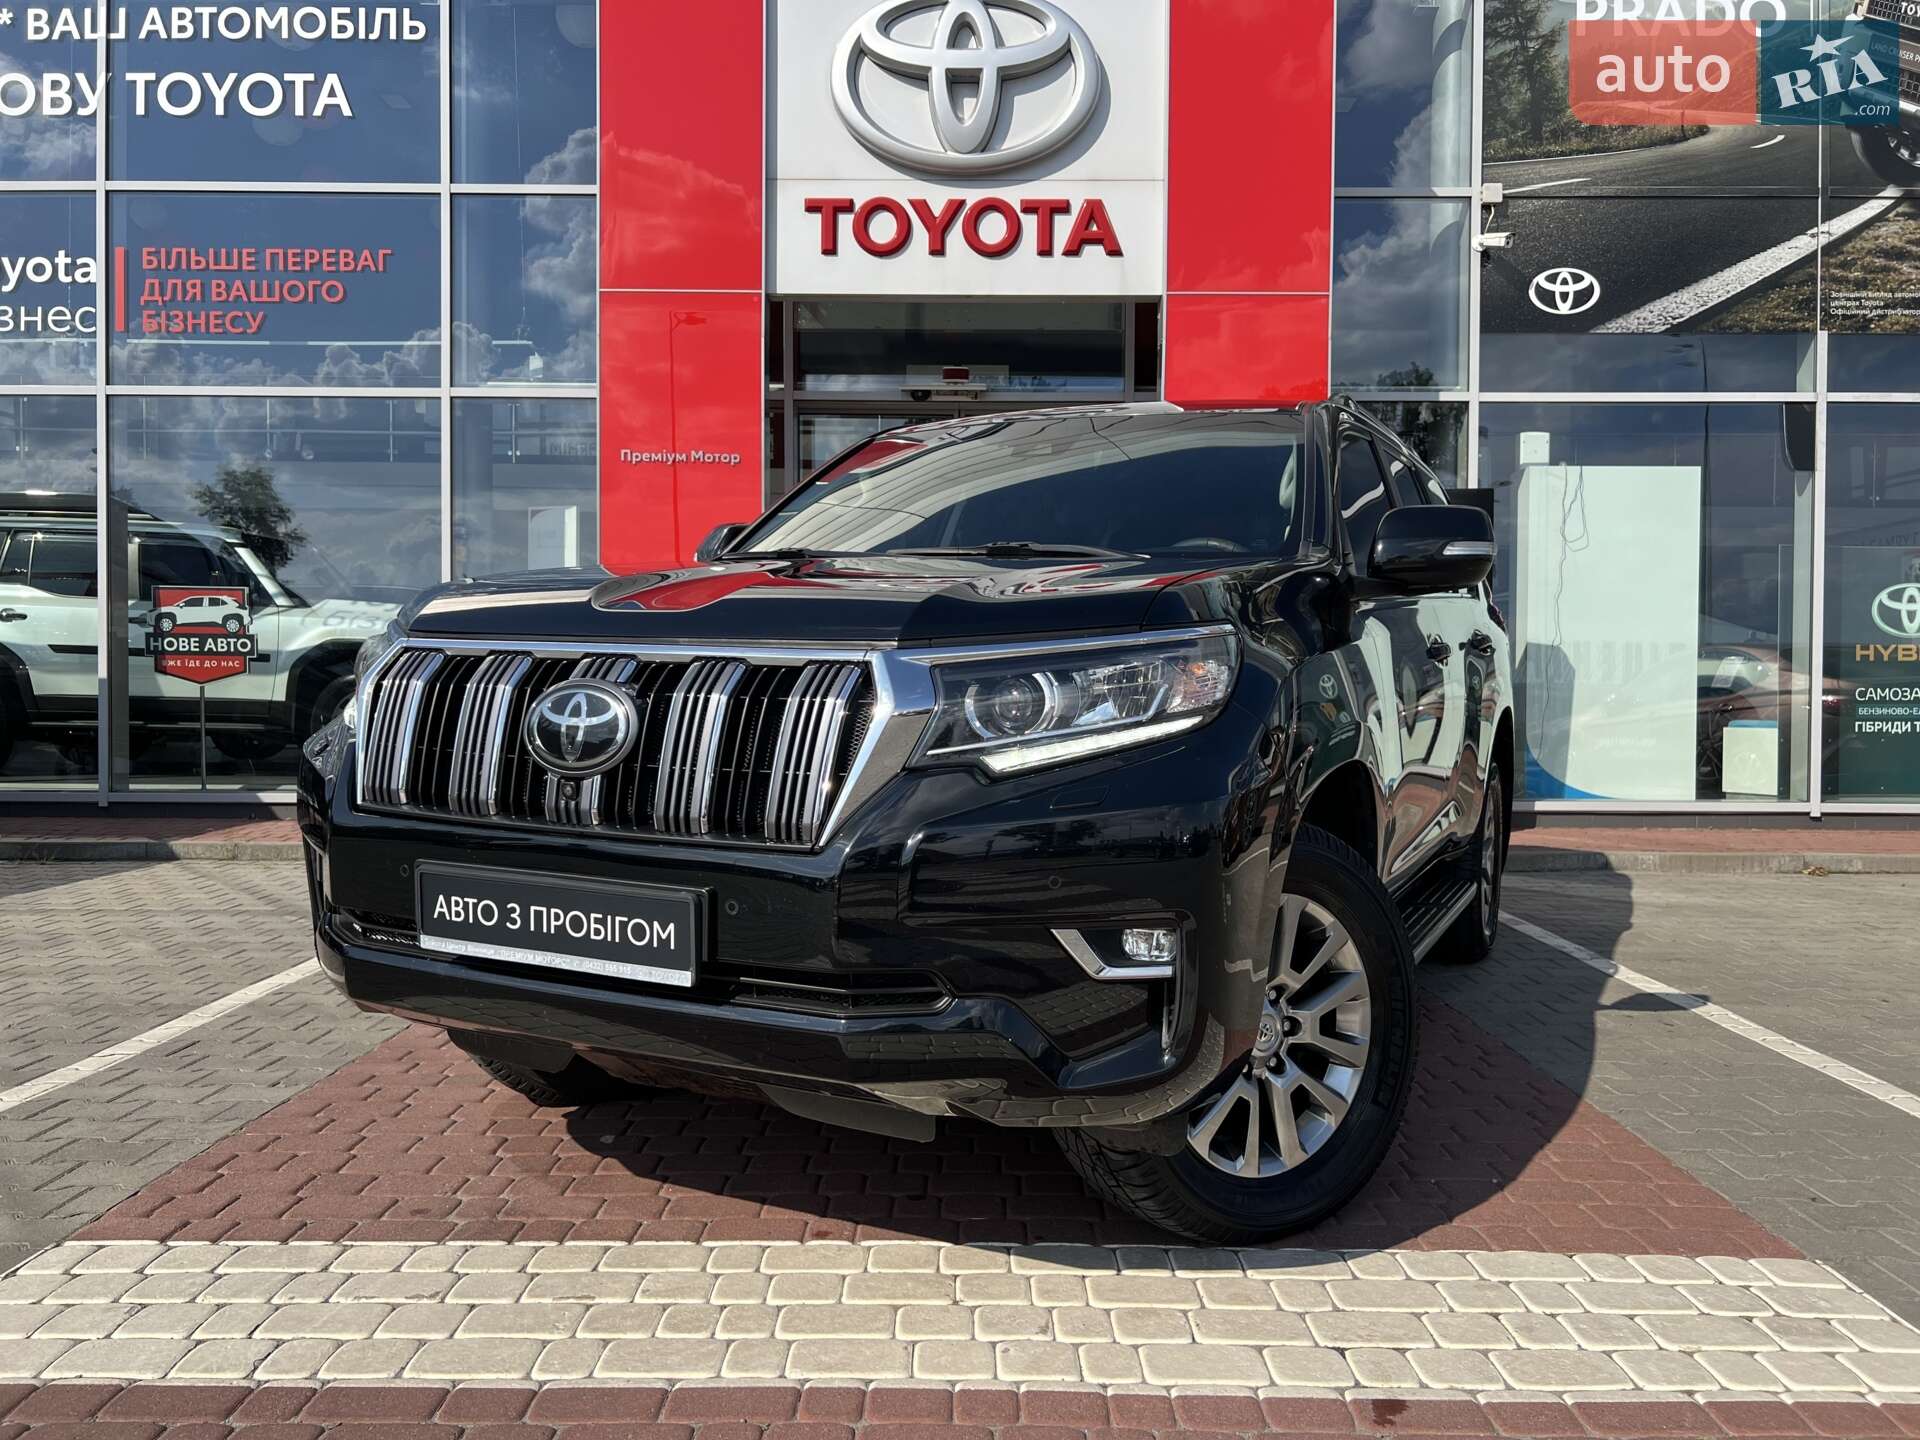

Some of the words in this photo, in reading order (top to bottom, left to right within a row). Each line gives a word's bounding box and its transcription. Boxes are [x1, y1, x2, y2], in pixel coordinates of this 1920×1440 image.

[28, 8, 126, 40] ВАШ
[138, 6, 427, 40] АВТОМОБІЛЬ
[1575, 0, 1787, 37] PRADO
[0, 72, 112, 116] ОВУ
[125, 72, 353, 117] TOYOTA
[804, 196, 1125, 258] TOYOTA
[1, 249, 97, 292] yota
[142, 247, 257, 271] БІЛЬШЕ
[265, 248, 393, 272] ПЕРЕВАГ
[140, 278, 202, 306] ДЛЯ
[211, 279, 345, 303] ВАШОГО
[142, 309, 265, 334] БІЗНЕСУ
[620, 449, 687, 464] Преміум
[690, 450, 740, 465] Мотор
[149, 637, 200, 652] НОВЕ
[204, 637, 252, 652] АВТО
[1855, 644, 1920, 662] HYB
[185, 658, 201, 668] ЇДЕ
[203, 660, 218, 668] ДО
[1855, 721, 1911, 734] ГІБРИДИ
[433, 894, 499, 926] АВТО
[529, 905, 675, 950] ПРОБІГОМ
